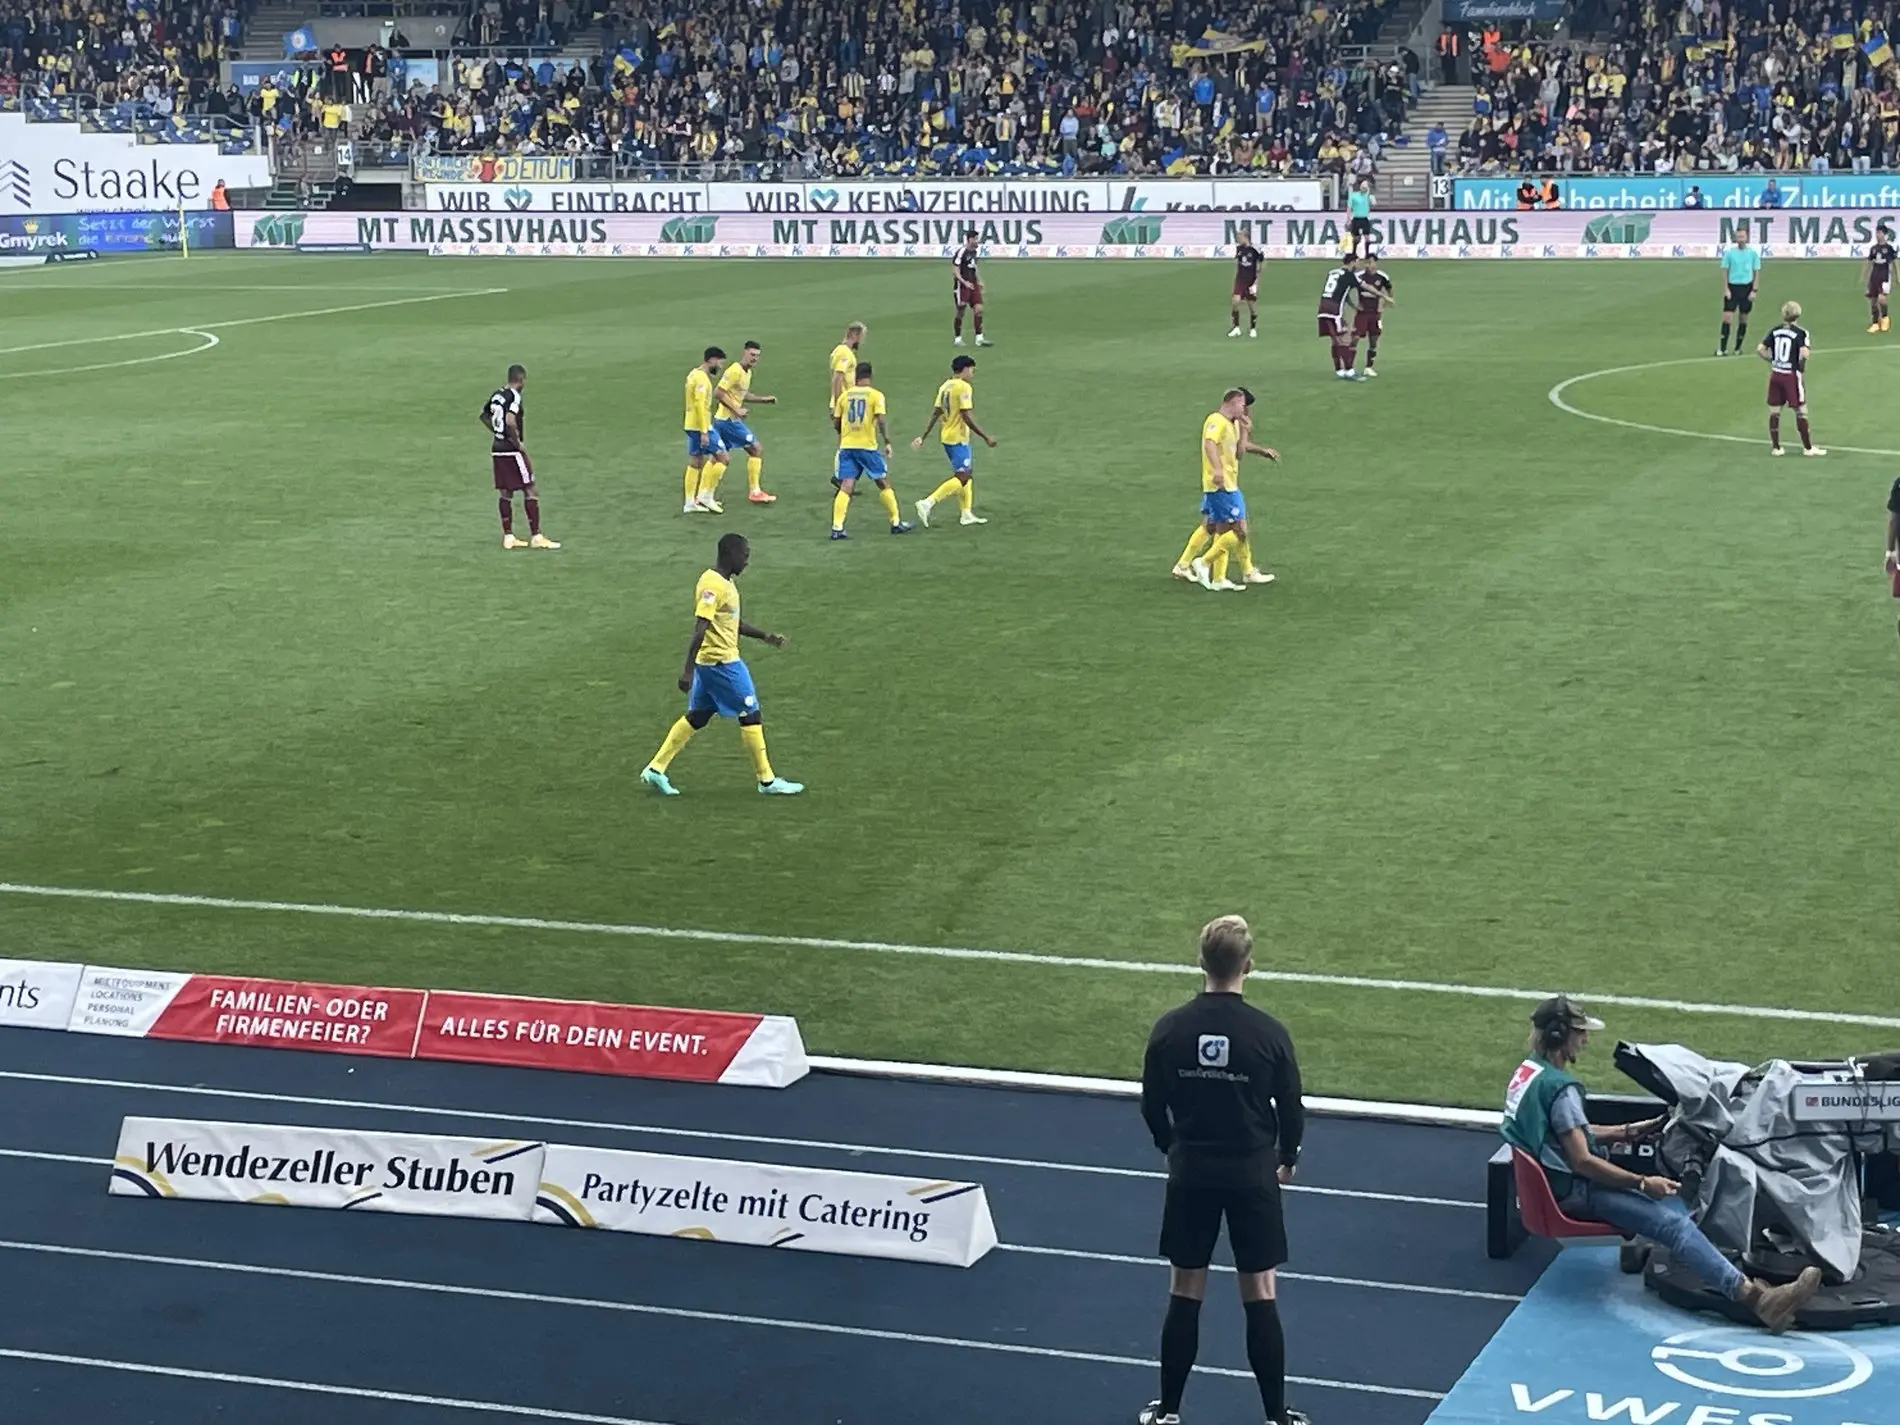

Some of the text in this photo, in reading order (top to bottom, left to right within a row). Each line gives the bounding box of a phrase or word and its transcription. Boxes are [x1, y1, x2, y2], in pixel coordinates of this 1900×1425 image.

[53, 158, 200, 200] Staake
[1432, 179, 1449, 196] 13
[438, 191, 702, 211] WIR EINTRACHT
[745, 191, 800, 211] WIR
[1463, 189, 1510, 209] Mit
[0, 231, 69, 251] Gmyrek
[357, 218, 607, 243] MT MASSIVHAUS
[773, 219, 1043, 244] MT MASSIVHAUS
[1286, 218, 1520, 245] MASIVHAUS
[1719, 216, 1774, 244] MT
[1774, 336, 1792, 362] 10
[0, 979, 41, 1009] nts
[91, 990, 143, 1002] LOCATIONS
[209, 988, 389, 1022] FAMILIEN- ODER
[87, 1002, 135, 1015] PERSONAL
[215, 1014, 372, 1045] FIRMENFEIER?
[439, 1015, 709, 1057] ALLES FÜR DEIN EVENT.
[145, 1141, 516, 1196] Wendezeller Stuben
[580, 1172, 932, 1243] Partyzelte mit Catering
